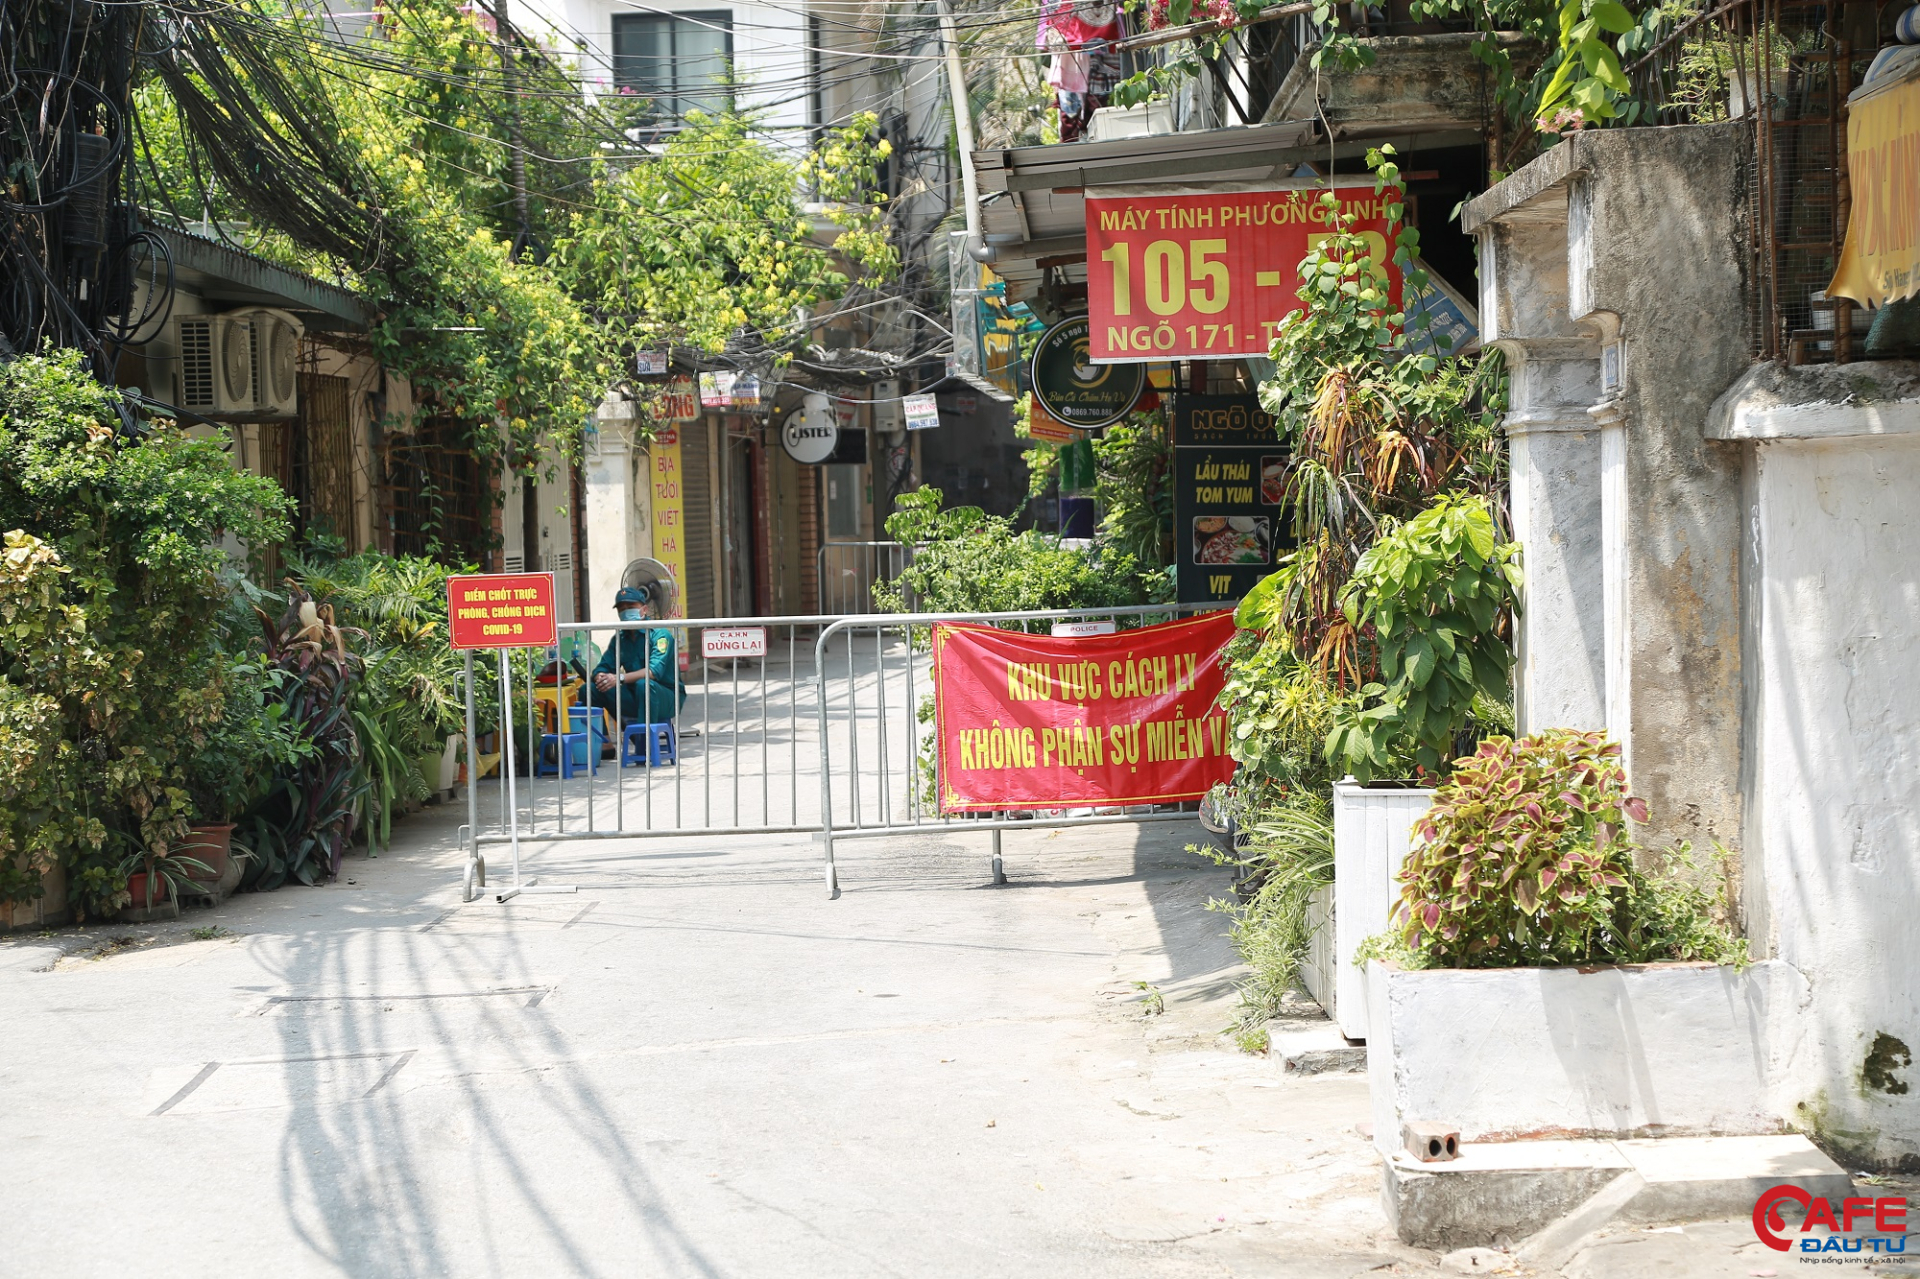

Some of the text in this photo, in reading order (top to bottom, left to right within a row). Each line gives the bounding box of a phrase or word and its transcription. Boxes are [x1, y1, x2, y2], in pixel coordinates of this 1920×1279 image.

[1100, 199, 1388, 231] MÁY TÍNH PHƯƠNG INH
[1101, 239, 1230, 316] 105
[1256, 271, 1280, 287] -
[1061, 331, 1068, 340] 5
[1107, 320, 1176, 351] NGÕ
[1186, 323, 1234, 348] 171
[1192, 405, 1247, 430] NGÕ
[1195, 455, 1251, 480] LẨU THÁI
[1195, 487, 1253, 503] TOM YUM
[657, 507, 679, 529] VIỆT
[662, 533, 677, 552] HÀ
[464, 586, 538, 602] ĐIỂM CHỐT TRỰC
[1209, 575, 1232, 600] VỊT
[458, 602, 546, 620] PHÒNG, CHỐNG DỊCH
[483, 623, 523, 636] COVID-19
[707, 639, 762, 652] DỪNG LẠI
[1007, 651, 1198, 709] KHU VỰC CÁCH LY
[959, 719, 1035, 770] KHÔNG
[1043, 718, 1103, 775] PHẬN
[1110, 718, 1140, 773] SỰ
[1146, 705, 1204, 763] MIỄN
